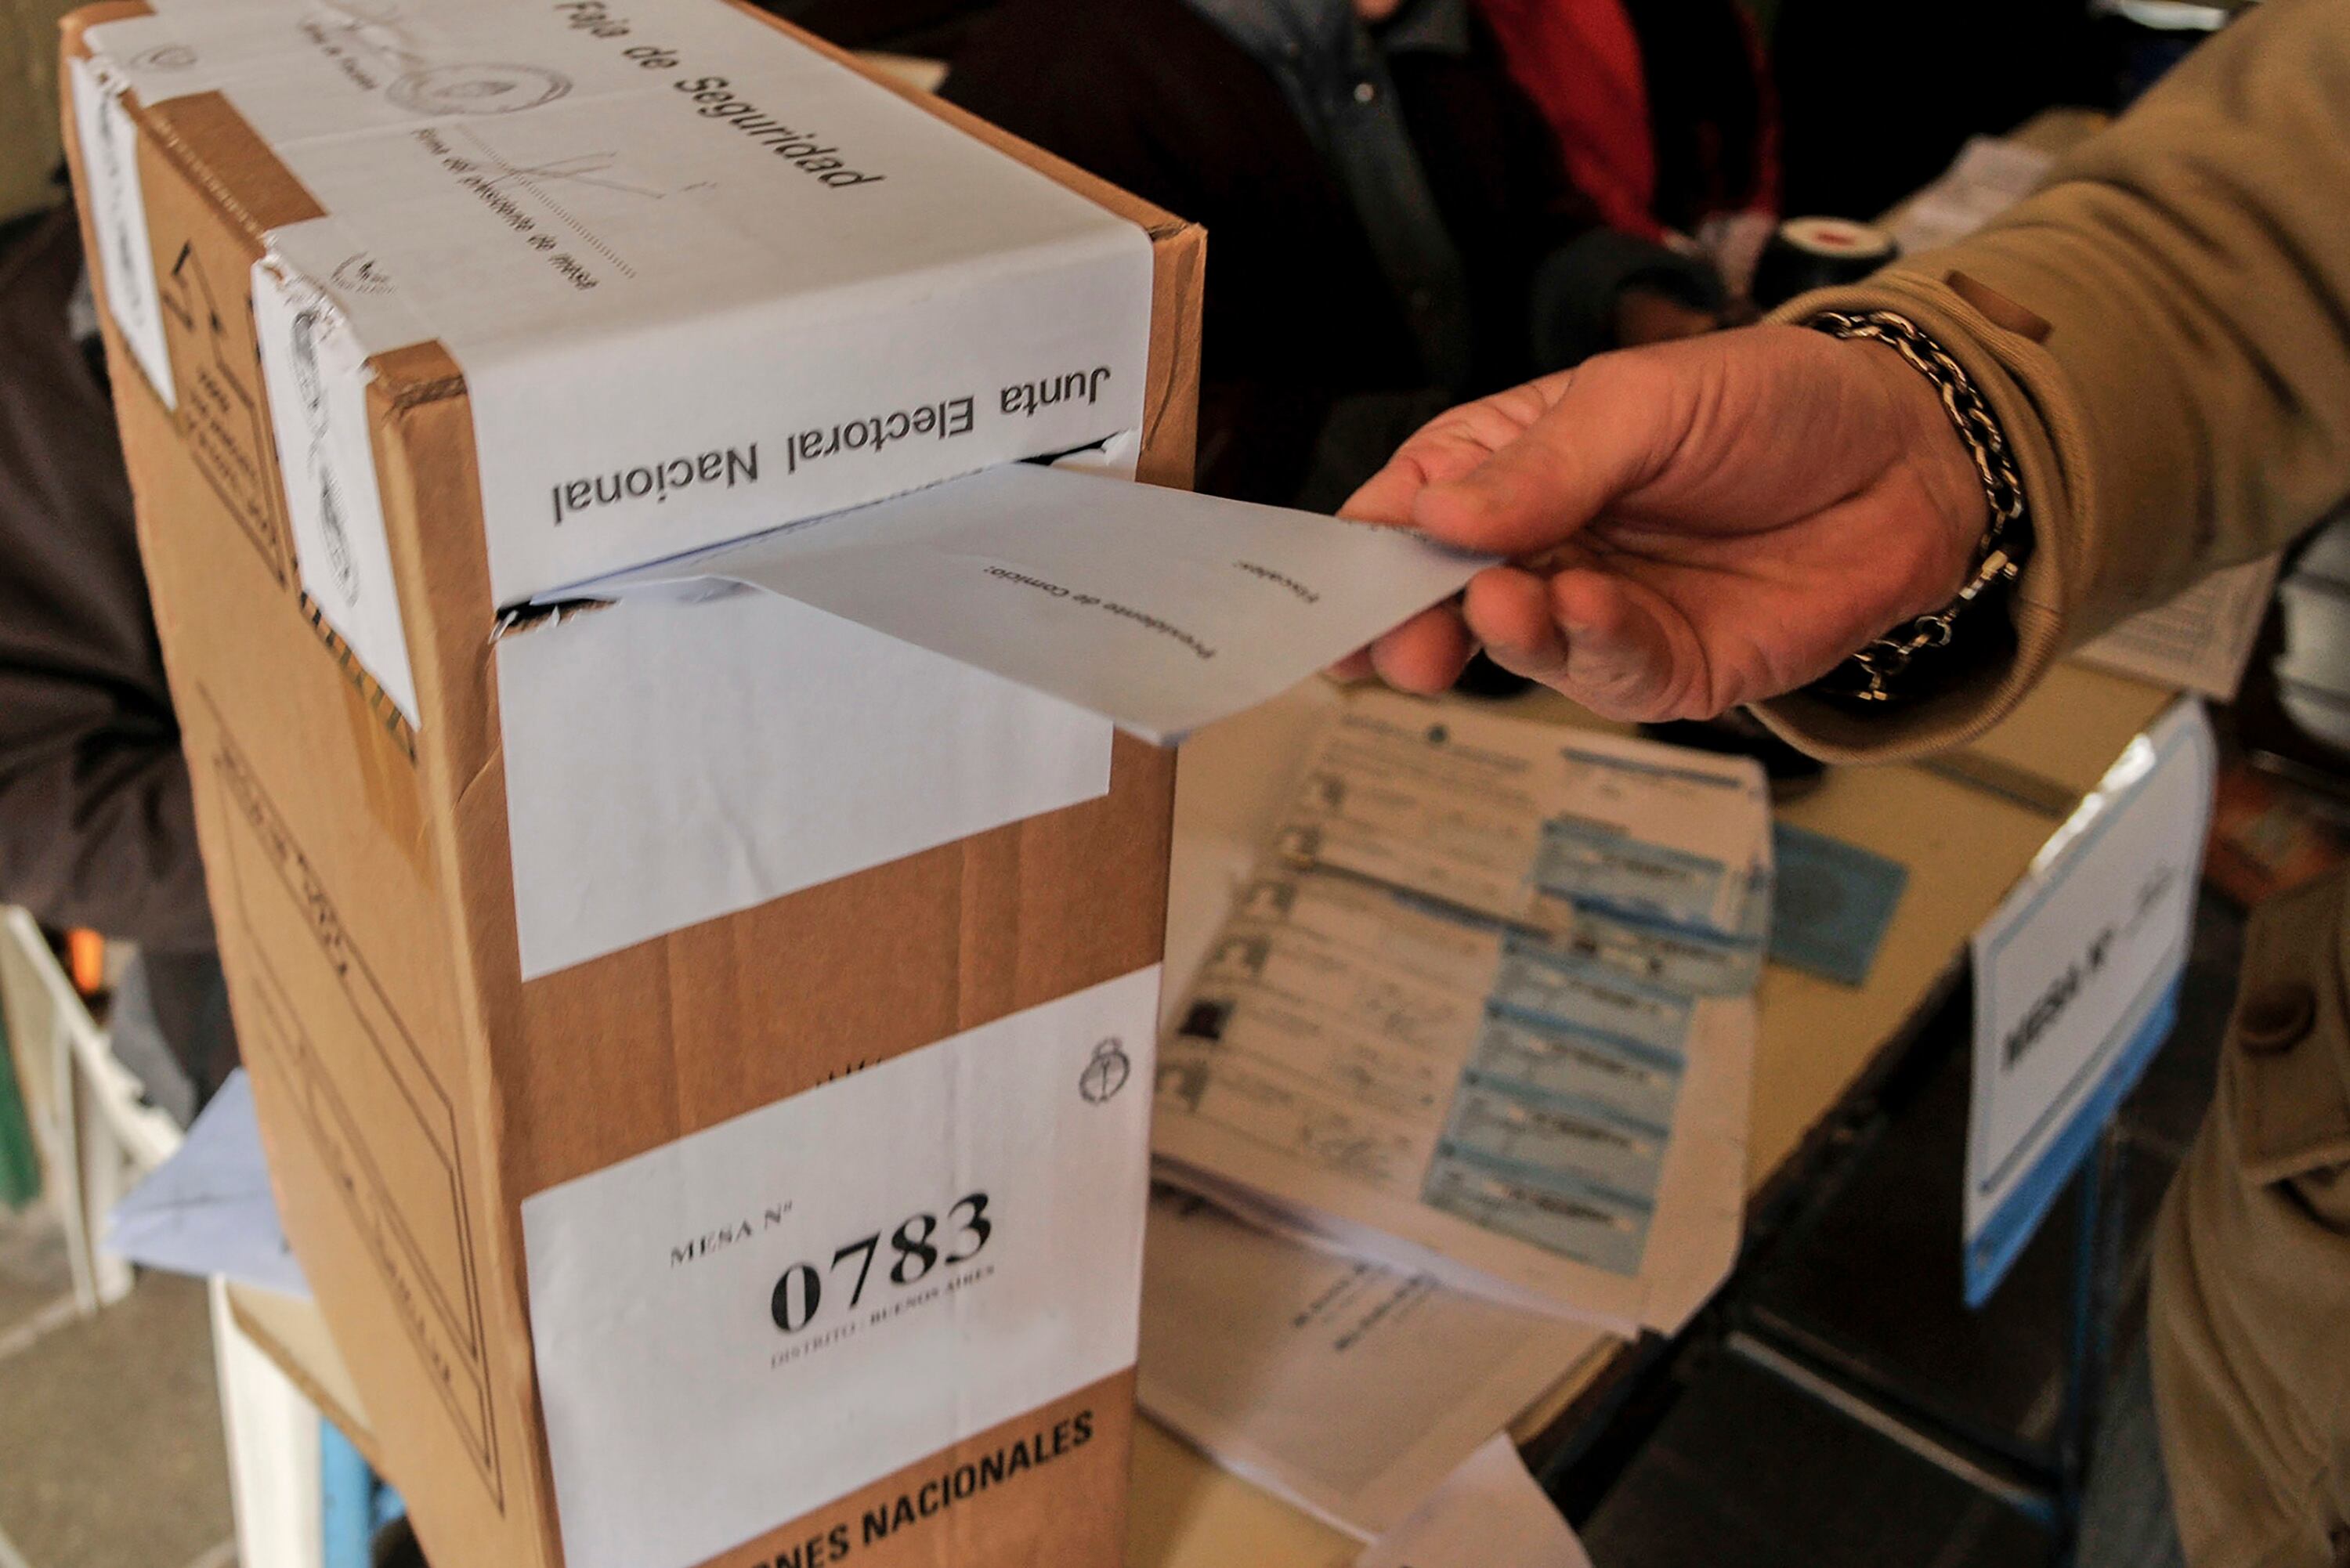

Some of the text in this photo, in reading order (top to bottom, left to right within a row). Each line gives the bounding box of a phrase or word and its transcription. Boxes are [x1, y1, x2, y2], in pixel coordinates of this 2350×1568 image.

[553, 0, 886, 190] Faja de Seguridad
[552, 365, 1112, 526] Junta Electoral Nacional
[983, 565, 1217, 659] Presidente de Comicio:
[670, 1219, 752, 1268] MESA
[771, 1192, 992, 1333] 0783
[751, 1409, 1094, 1568] NES NACIONALES
